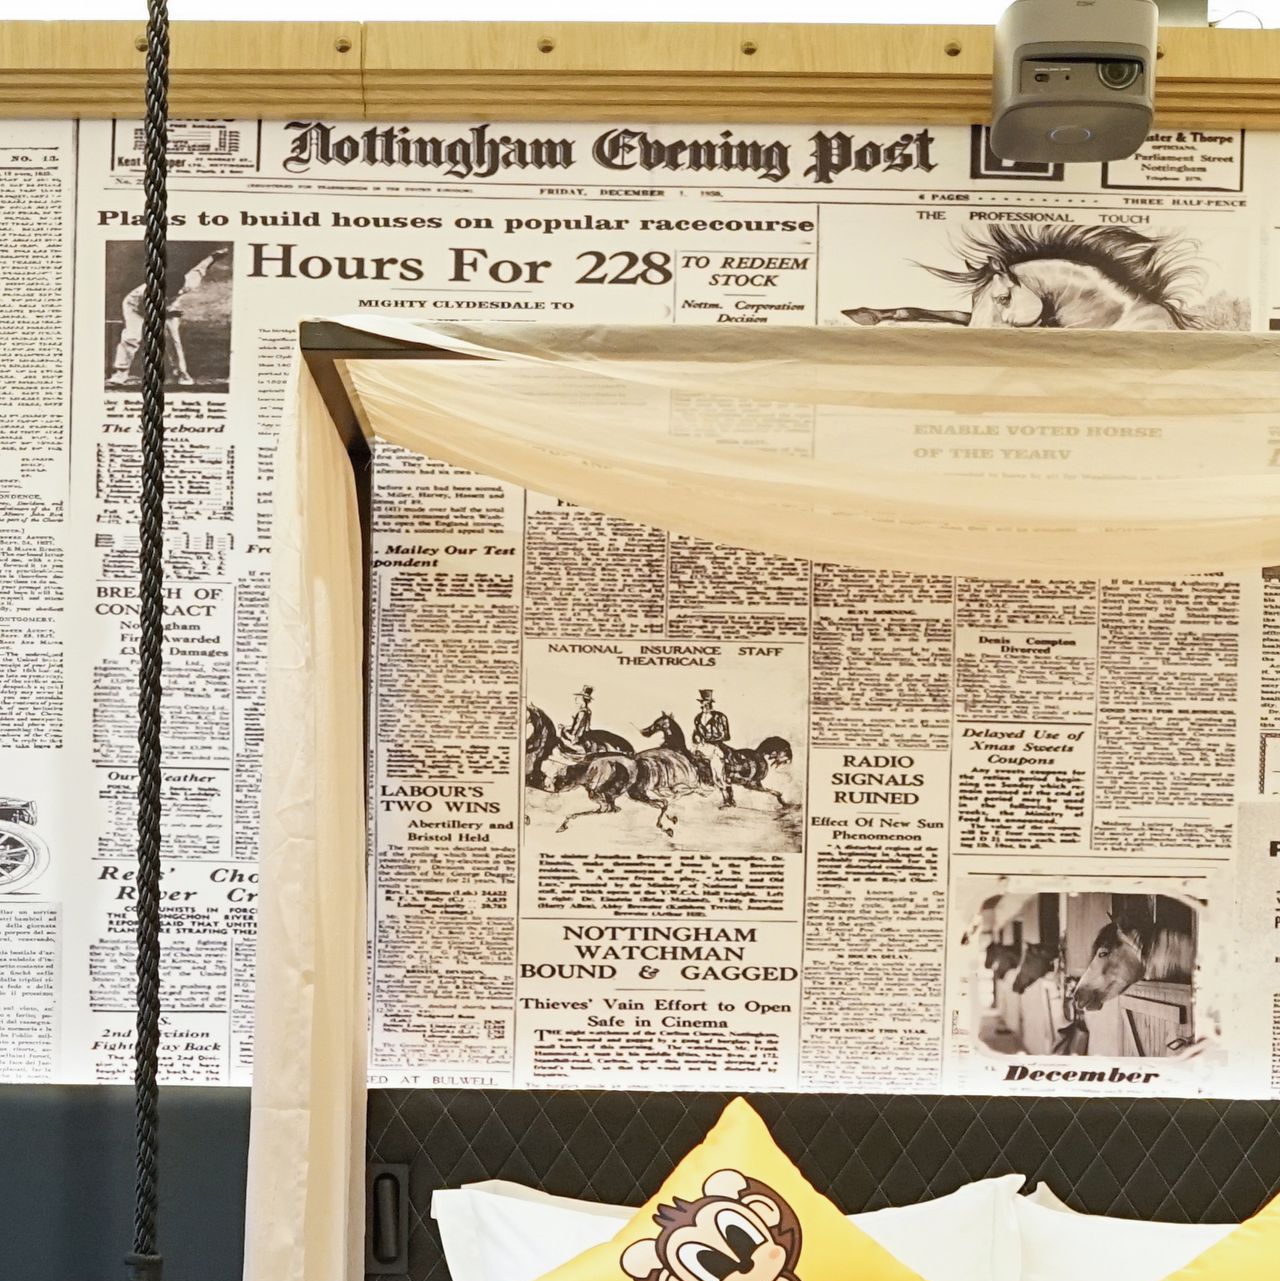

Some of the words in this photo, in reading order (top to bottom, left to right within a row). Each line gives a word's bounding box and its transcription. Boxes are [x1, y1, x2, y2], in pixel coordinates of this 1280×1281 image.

[281, 120, 578, 179] Nottingham
[592, 129, 791, 181] Evening
[809, 128, 938, 183] Post
[97, 210, 186, 226] Plas
[198, 212, 229, 226] to
[240, 211, 320, 226] build
[332, 212, 442, 228] houses
[455, 218, 493, 228] on
[505, 215, 629, 234] popular
[640, 220, 814, 232] racecourse
[917, 211, 946, 220] THE
[970, 212, 1074, 222] PROFESSIONAL
[1099, 214, 1149, 224] TOUCH
[247, 243, 424, 281] Hours
[449, 248, 552, 283] For
[576, 251, 672, 285] 228
[683, 256, 710, 268] TO
[720, 257, 809, 269] REDEEM
[709, 274, 778, 286] STOCK
[433, 301, 543, 309] CLYDESDALE
[914, 424, 999, 438] ENABLE
[1004, 424, 1072, 438] VOTED
[1082, 425, 1161, 438] HORSE
[914, 448, 942, 459] OF
[950, 448, 991, 459] THE
[385, 545, 439, 556] Mailey
[444, 545, 477, 554] Our
[484, 546, 515, 555] Test
[549, 644, 622, 654] NATIONAL
[641, 646, 721, 655] INSURANCE
[738, 647, 783, 656] STAFF
[617, 656, 716, 666] THEATRICALS
[962, 728, 1025, 739] Delayed
[1034, 730, 1059, 739] Use
[1067, 731, 1084, 741] of
[970, 741, 1012, 751] Xmas
[1023, 743, 1073, 752] Sweets
[844, 755, 914, 768] RADIO
[988, 755, 1054, 765] Coupons
[832, 773, 924, 786] SIGNALS
[381, 785, 483, 797] LABOUR'S
[835, 791, 919, 804] RUINED
[381, 800, 432, 812] TWO
[445, 801, 500, 813] WINS
[408, 820, 482, 830] Abertillery
[489, 821, 513, 829] and
[811, 817, 848, 826] Effect
[855, 818, 872, 827] Of
[880, 818, 910, 827] New
[917, 819, 943, 828] Sun
[408, 833, 451, 841] Bristol
[459, 833, 489, 842] Held
[833, 830, 921, 841] Phenomenon
[563, 926, 756, 942] NOTTINGHAM
[575, 945, 744, 961] WATCHMAN
[520, 964, 616, 979] BOUND
[639, 965, 660, 978] &
[680, 966, 798, 981] GAGGED
[521, 998, 592, 1011] Thieves'
[605, 1000, 645, 1011] Vain
[655, 999, 708, 1011] Effort
[718, 1001, 735, 1012] to
[744, 1002, 792, 1014] Open
[588, 1016, 622, 1027] Safe
[636, 1016, 651, 1027] in
[662, 1016, 728, 1028] Cinema
[1004, 1066, 1159, 1083] December
